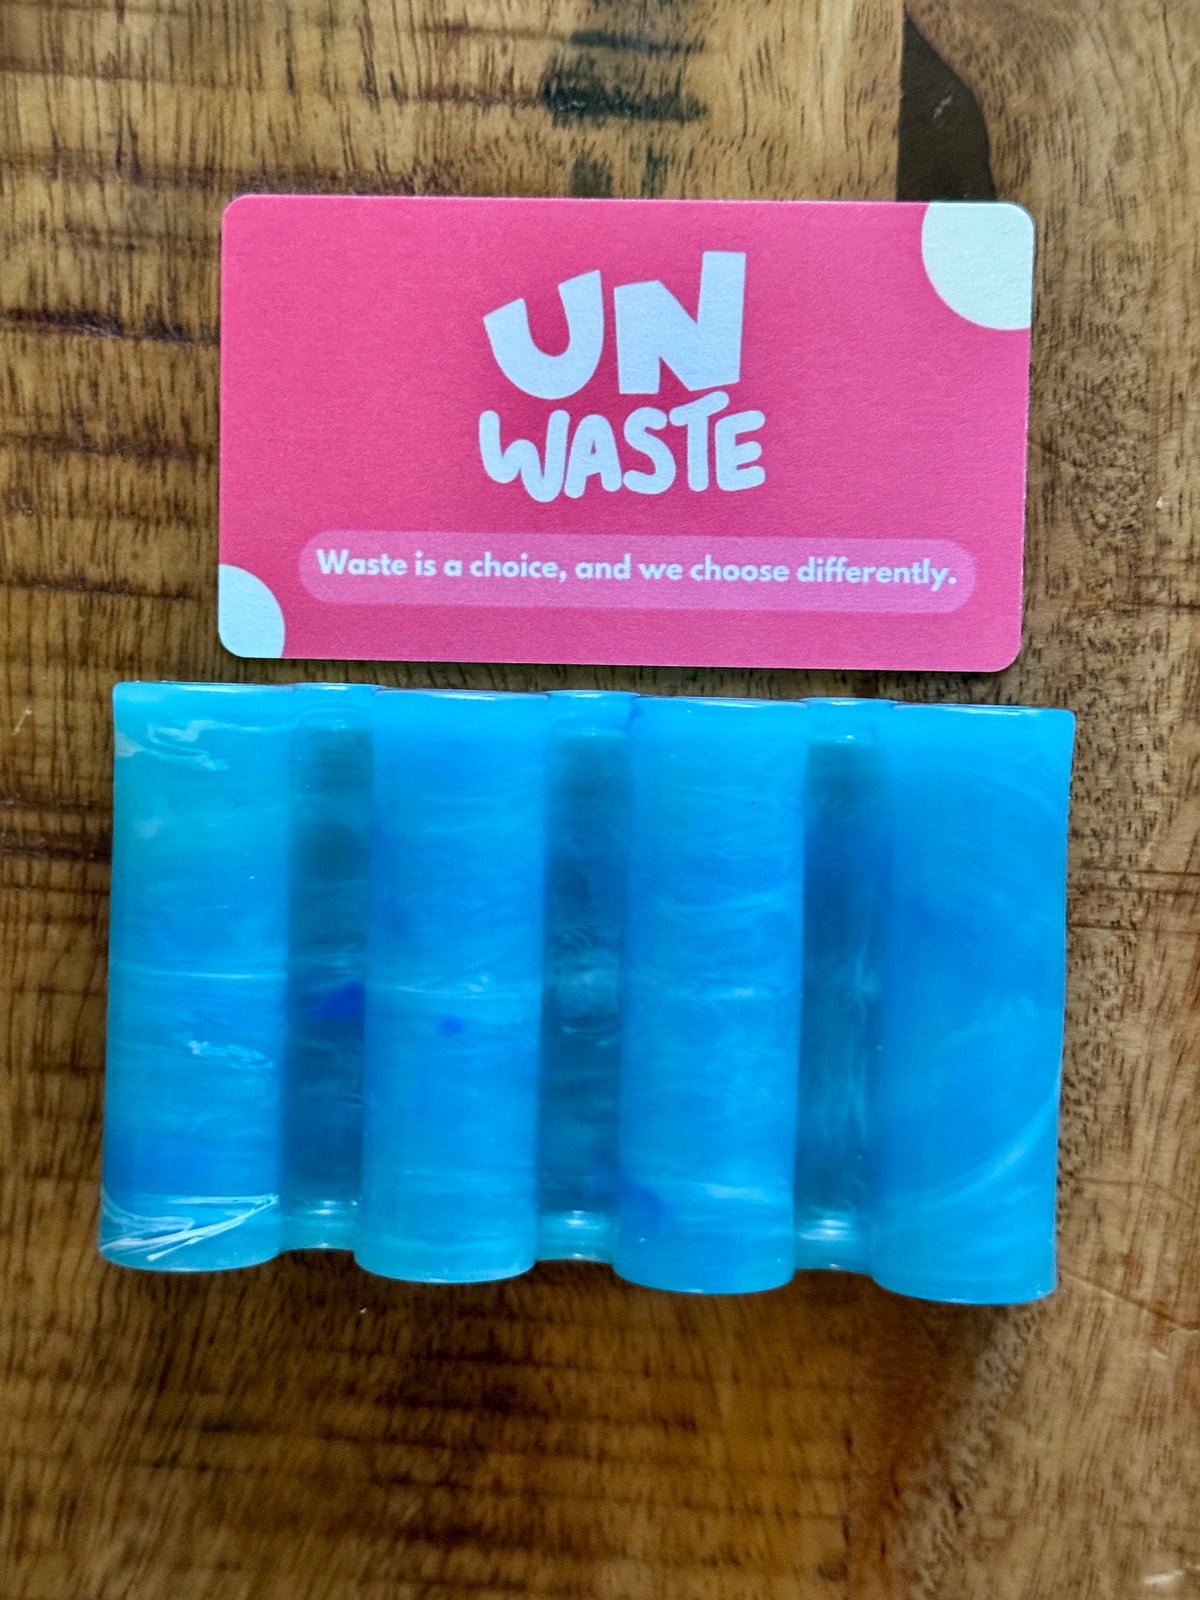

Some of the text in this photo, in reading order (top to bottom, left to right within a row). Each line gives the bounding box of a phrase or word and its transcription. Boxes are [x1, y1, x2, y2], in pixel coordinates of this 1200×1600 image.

[483, 251, 746, 400] UN
[478, 391, 767, 503] WASTE
[316, 549, 957, 593] Waste is a choice, and we choose differently.
